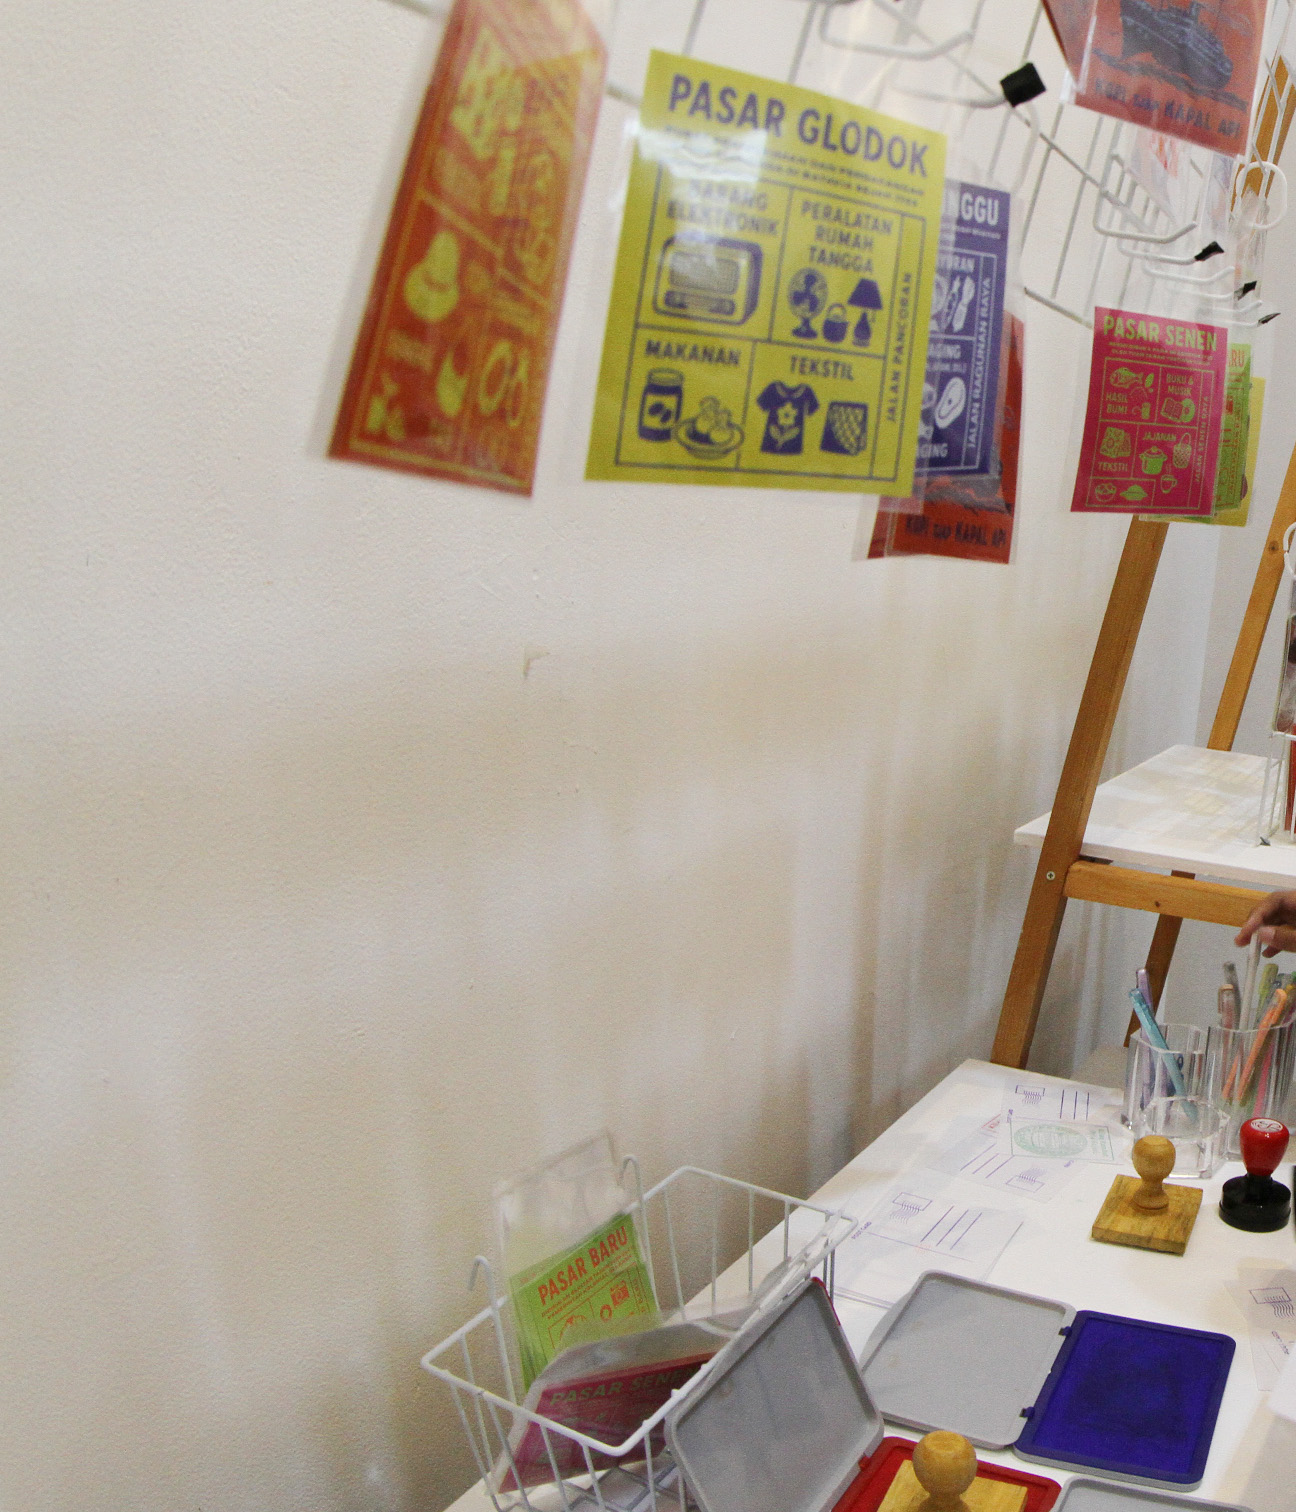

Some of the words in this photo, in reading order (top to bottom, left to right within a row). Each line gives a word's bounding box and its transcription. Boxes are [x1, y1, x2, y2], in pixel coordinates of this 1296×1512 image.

[668, 73, 785, 138] PASAR
[797, 107, 928, 178] GLODOK
[801, 199, 892, 235] PERALATAN
[814, 224, 874, 251] RUMAH
[808, 245, 873, 273] TANGGA
[978, 277, 991, 318] RAYA
[1103, 315, 1160, 343] PASAR
[1165, 326, 1217, 352] SENEN
[644, 339, 742, 367] MAKANAN
[789, 353, 855, 381] TEKSTIL
[971, 320, 987, 400] RAGUNAN
[966, 401, 980, 449] JALAN
[537, 1257, 588, 1306] PASAR
[588, 1225, 628, 1268] BARU
[550, 1382, 623, 1405] PASAR
